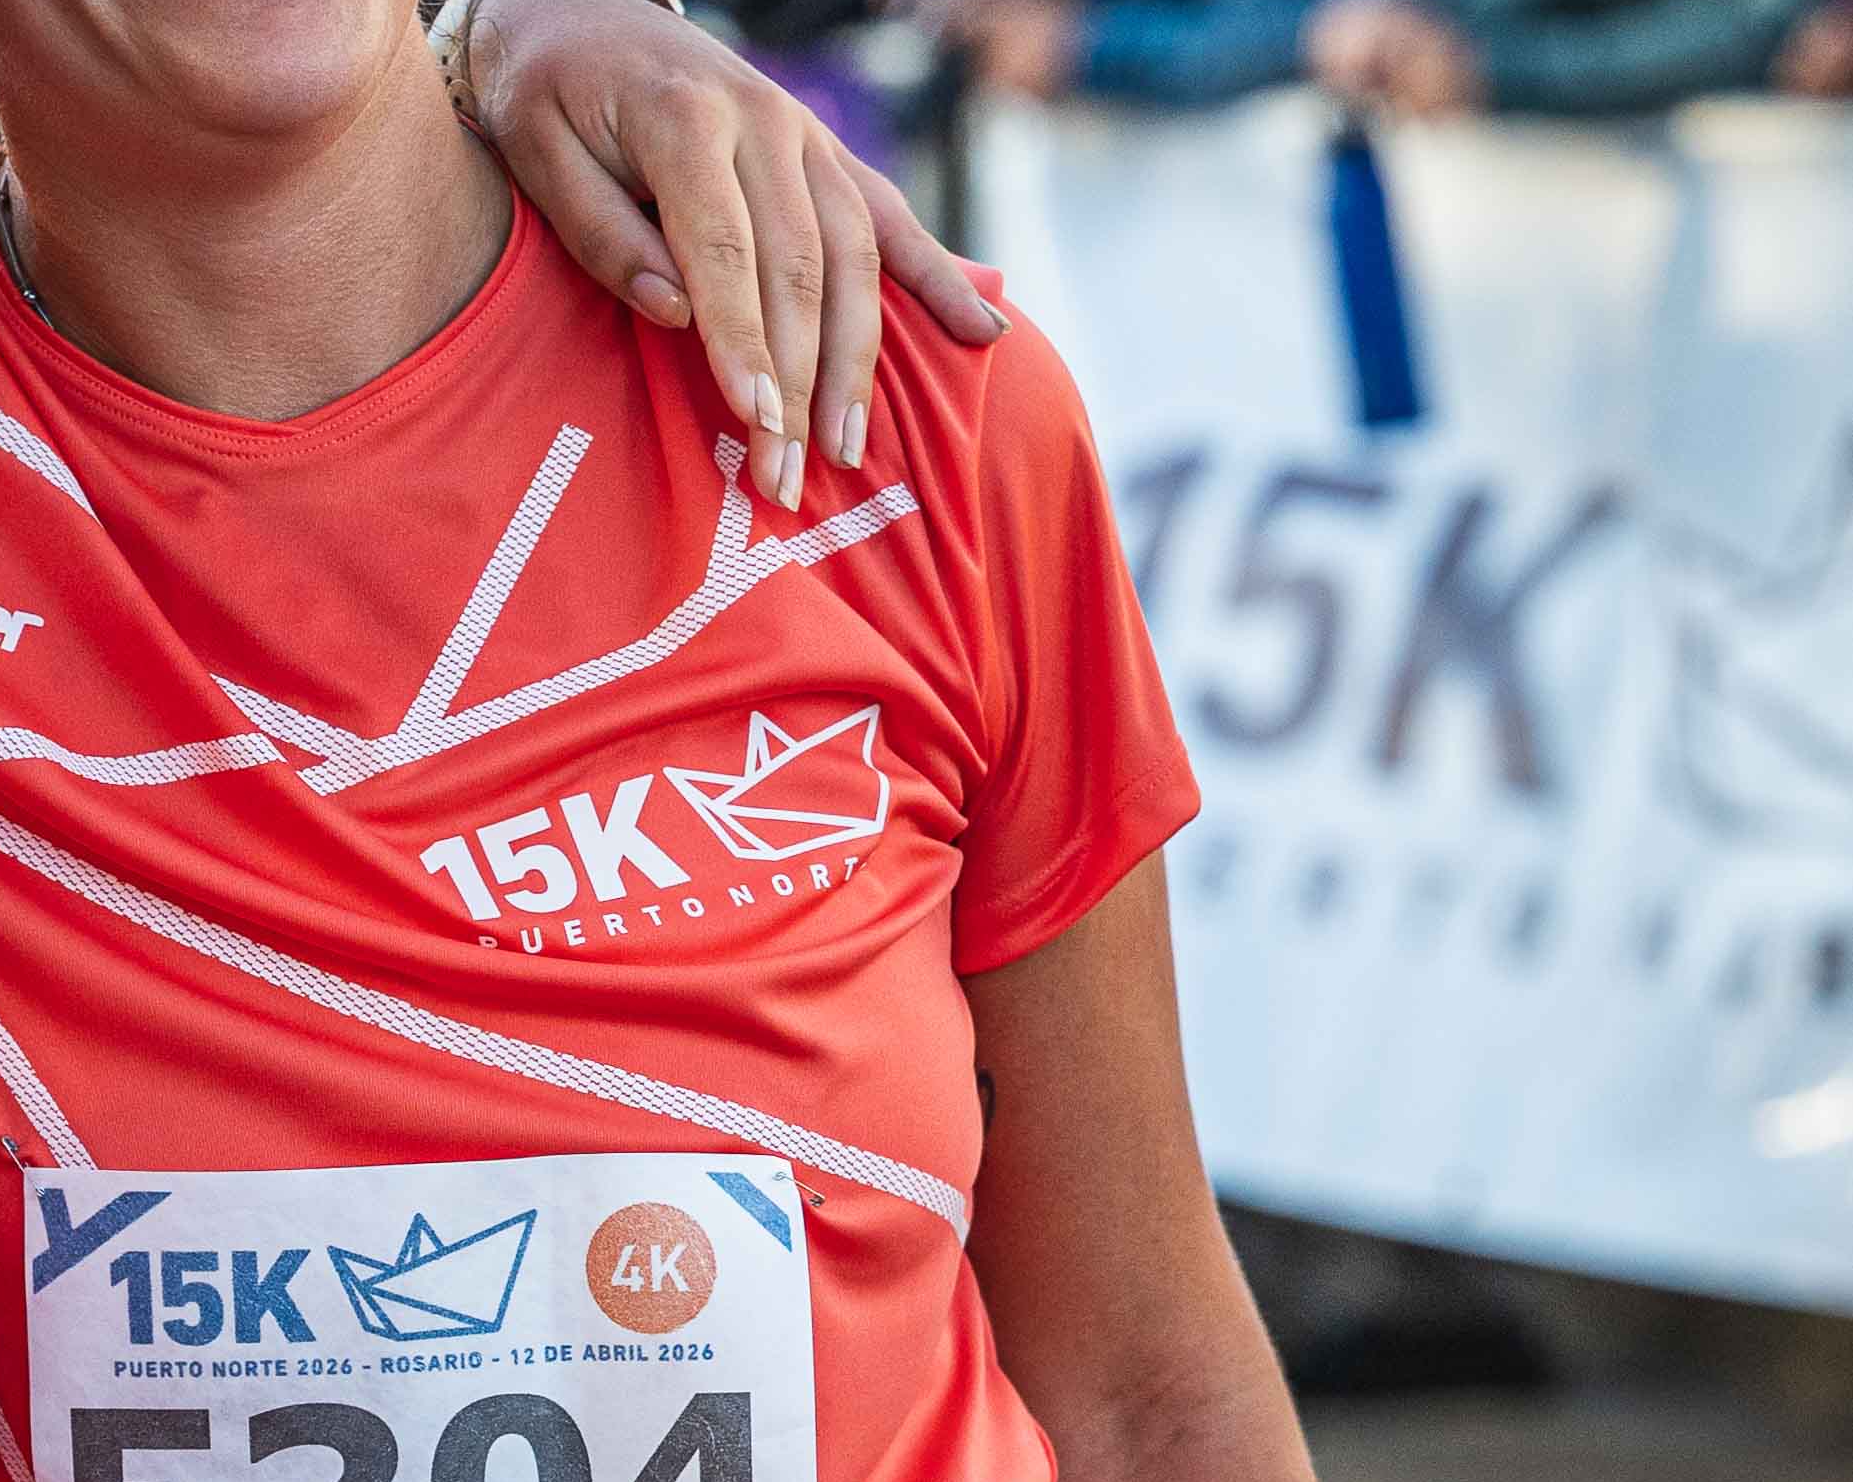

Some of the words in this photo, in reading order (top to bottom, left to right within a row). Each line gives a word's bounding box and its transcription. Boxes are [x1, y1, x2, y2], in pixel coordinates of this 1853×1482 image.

[419, 773, 691, 921] 15K
[727, 856, 867, 908] NORT
[612, 1243, 691, 1294] 4K
[110, 1248, 316, 1345] 15K
[113, 1360, 203, 1378] PUERTO
[213, 1359, 288, 1377] NORTE
[298, 1358, 353, 1376] 2026
[381, 1351, 482, 1375] ROSARIO
[511, 1348, 536, 1366] 12
[544, 1345, 573, 1363] DE
[583, 1343, 648, 1362] ABRIL
[658, 1342, 715, 1362] 2026
